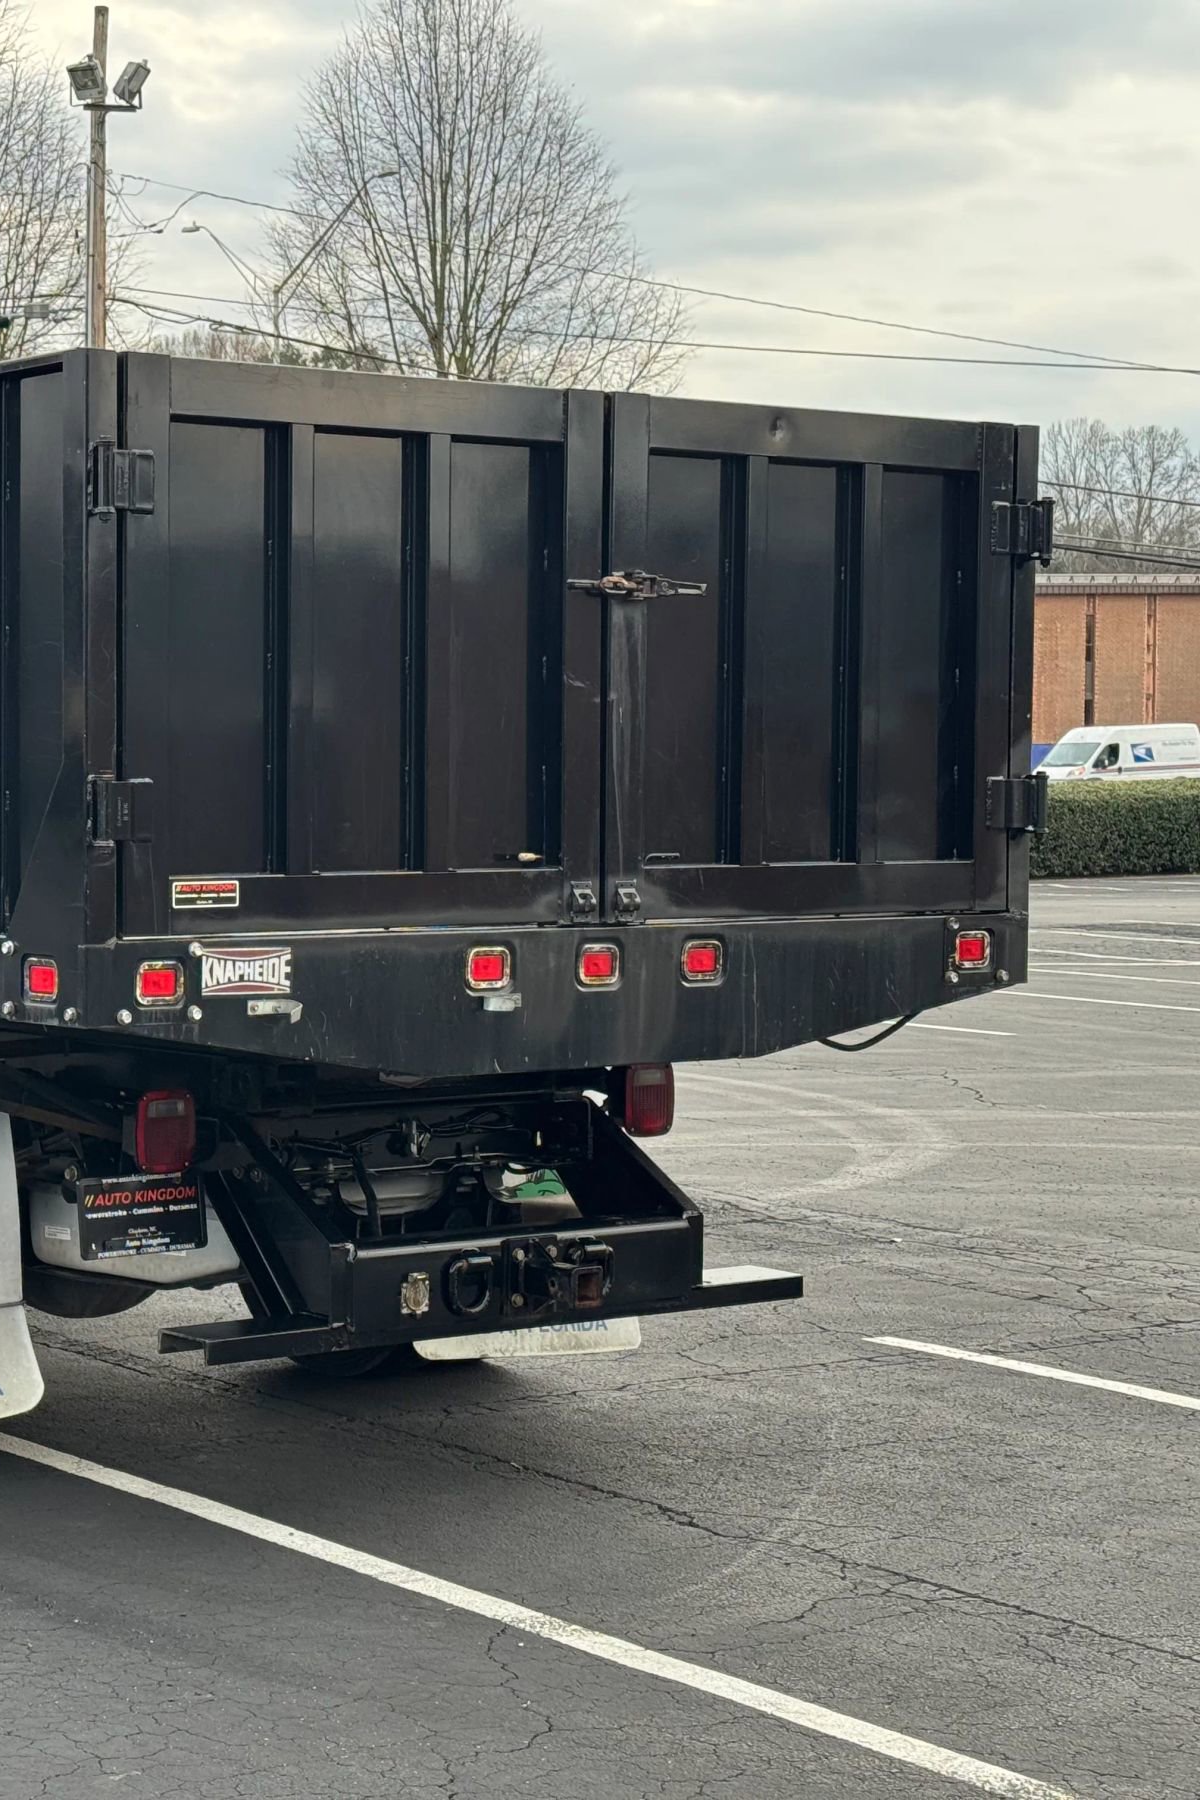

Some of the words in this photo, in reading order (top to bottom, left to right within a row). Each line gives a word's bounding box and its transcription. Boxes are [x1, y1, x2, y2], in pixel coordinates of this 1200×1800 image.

[201, 953, 292, 988] KNAPHEIDE
[95, 1192, 131, 1207] AUTO
[135, 1186, 196, 1203] KINGDOM
[132, 1206, 164, 1215] Cummins
[169, 1203, 197, 1211] Duramax
